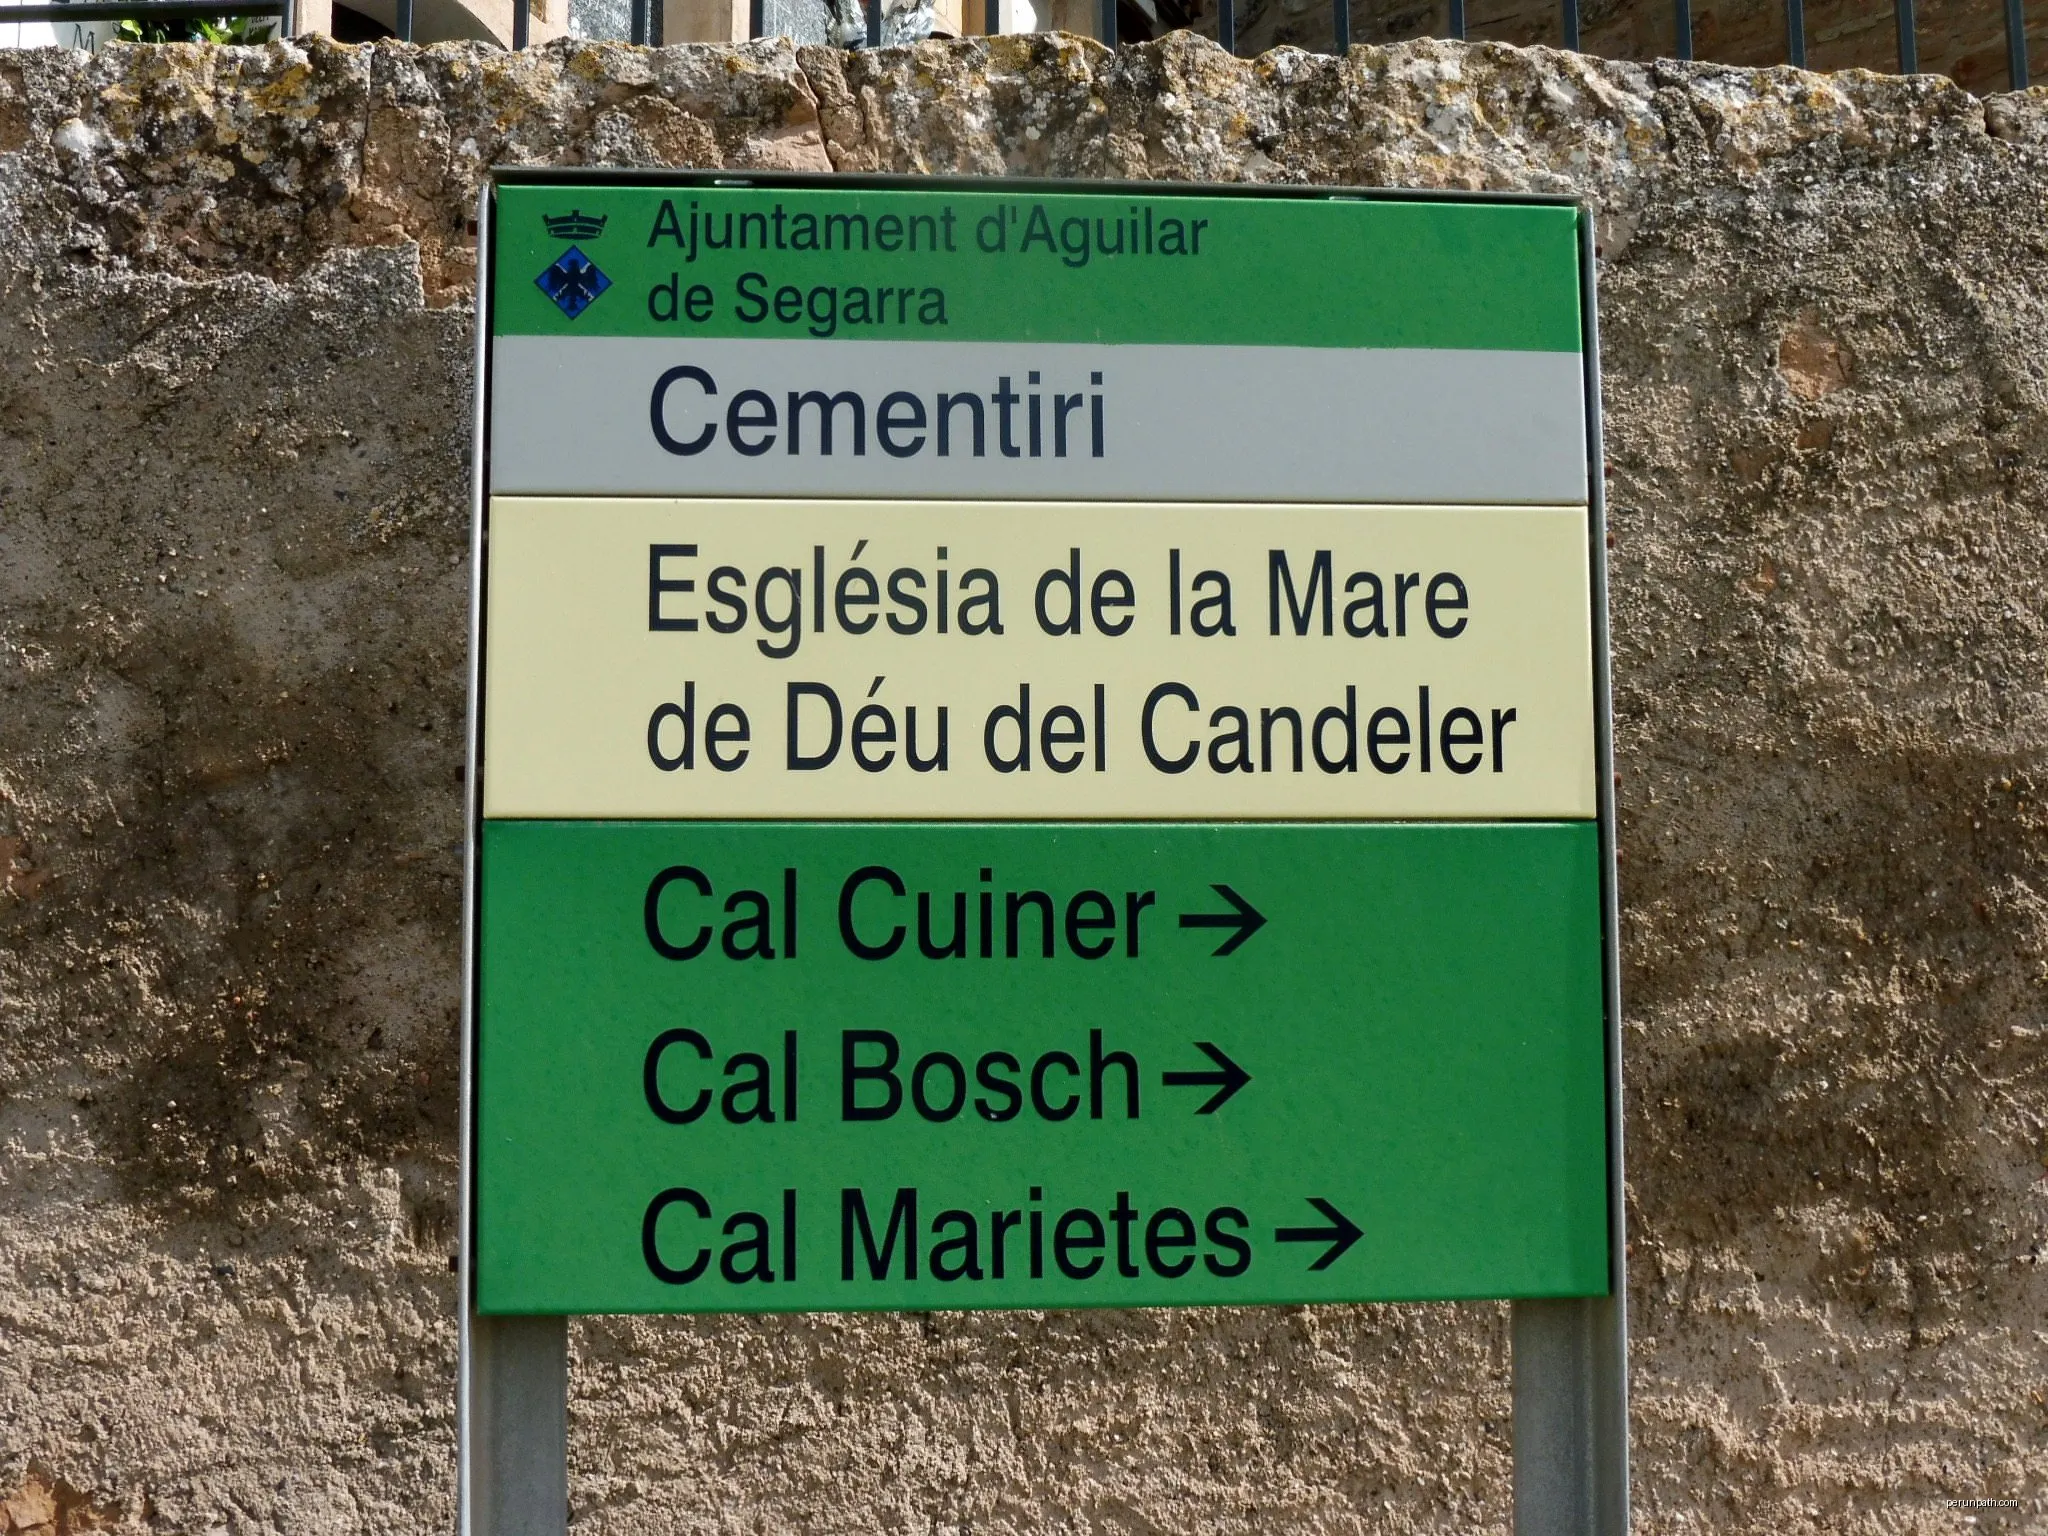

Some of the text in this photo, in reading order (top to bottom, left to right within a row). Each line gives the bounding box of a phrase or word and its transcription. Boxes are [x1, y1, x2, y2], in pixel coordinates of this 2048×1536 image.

[647, 199, 1208, 268] Ajuntament d'Aguilar
[647, 271, 948, 338] de Segarra
[650, 365, 1104, 458] Cementiri
[649, 540, 1468, 659] Església de la Mare
[647, 676, 1516, 775] de Déu del Candeler
[643, 865, 1156, 962] Cal Cuiner
[642, 1027, 1140, 1126] Cal Bosch
[641, 1186, 1252, 1286] Cal Marietes
